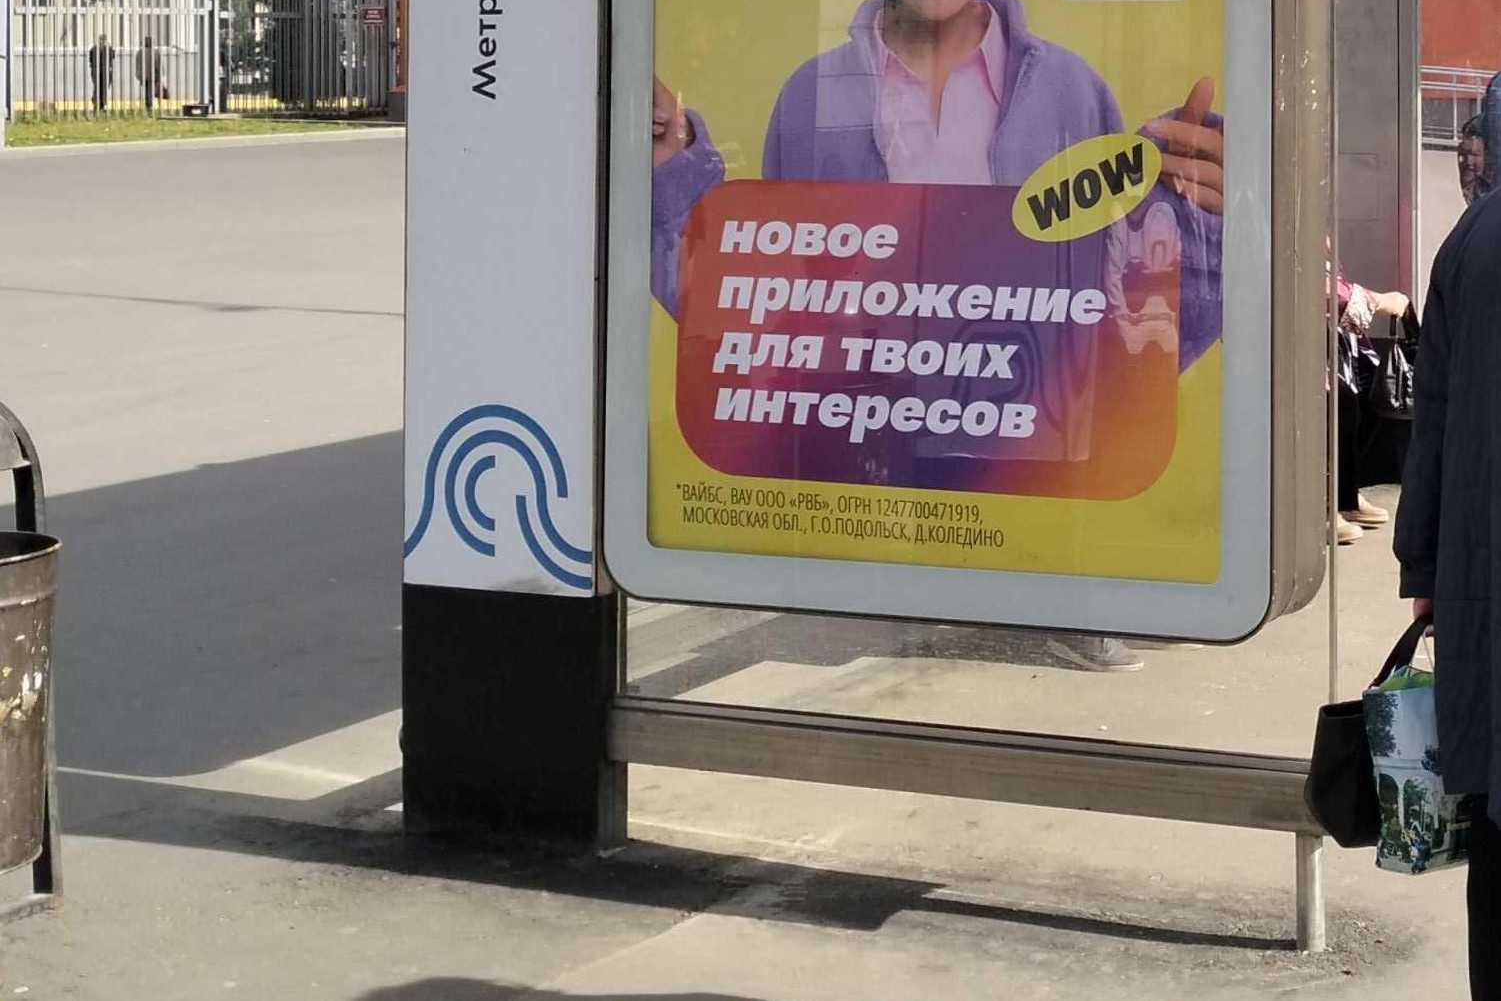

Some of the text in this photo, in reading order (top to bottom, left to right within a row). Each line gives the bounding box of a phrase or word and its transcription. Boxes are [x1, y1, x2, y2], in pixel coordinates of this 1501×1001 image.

[1026, 142, 1145, 232] WOW
[718, 219, 899, 260] новое
[717, 275, 1108, 326] приложение
[711, 332, 1019, 380] для твоих
[713, 387, 1038, 444] интересов
[683, 506, 1005, 549] МОСКОВСКАЯ ОБЛ., Г.О.ПОДОЛЬСК, Д.КОЛЕДИНО
[730, 487, 753, 506] ВАУ
[756, 489, 785, 509] ООО
[789, 493, 833, 514] «РВБ»,
[837, 495, 872, 516] ОГРН
[876, 498, 984, 526] 1247700471919,
